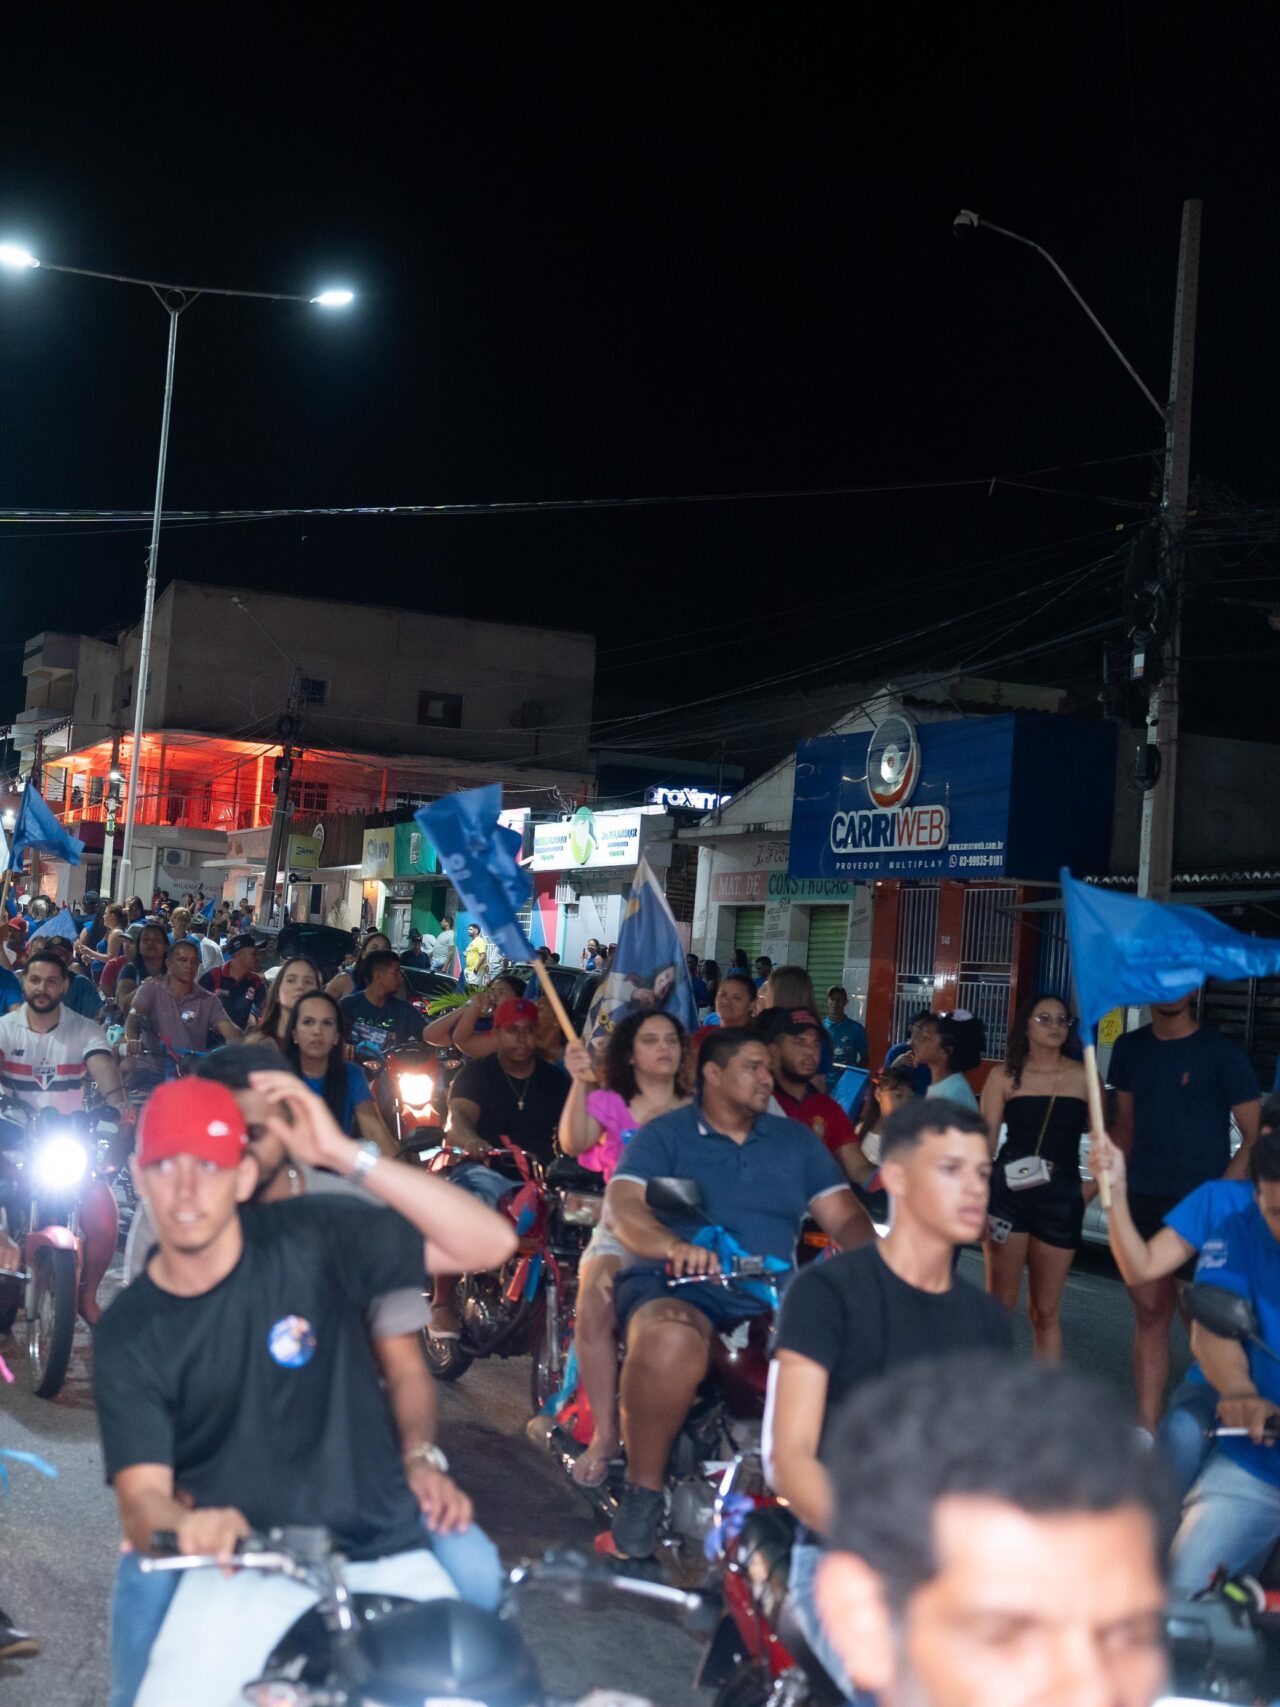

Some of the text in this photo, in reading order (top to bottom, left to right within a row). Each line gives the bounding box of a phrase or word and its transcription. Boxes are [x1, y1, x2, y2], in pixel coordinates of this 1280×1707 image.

[836, 859, 943, 870] PROVEDOR MULTIPLAY
[745, 874, 761, 896] DE
